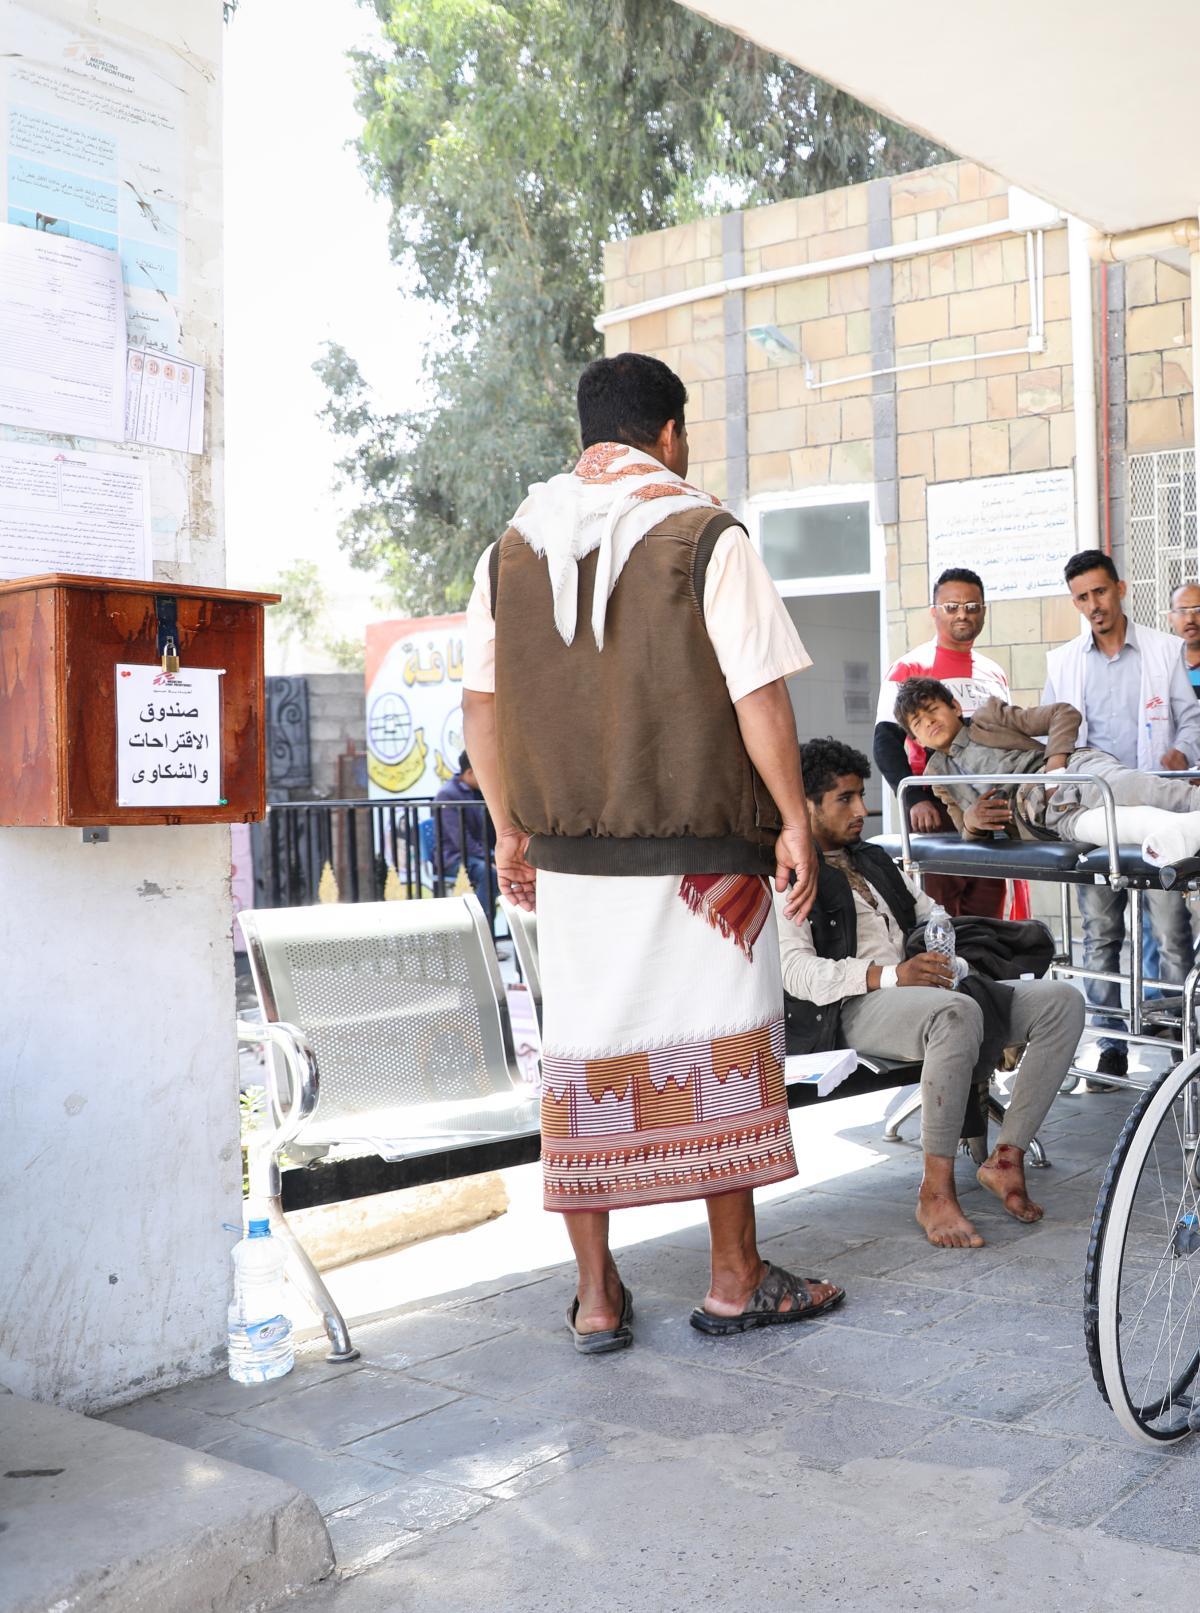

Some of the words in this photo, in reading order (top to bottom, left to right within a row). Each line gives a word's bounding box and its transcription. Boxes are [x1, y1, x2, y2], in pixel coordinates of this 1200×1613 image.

[139, 702, 199, 723] صندوق
[128, 730, 209, 753] الاقتراحات
[131, 762, 209, 784] والشكاوى
